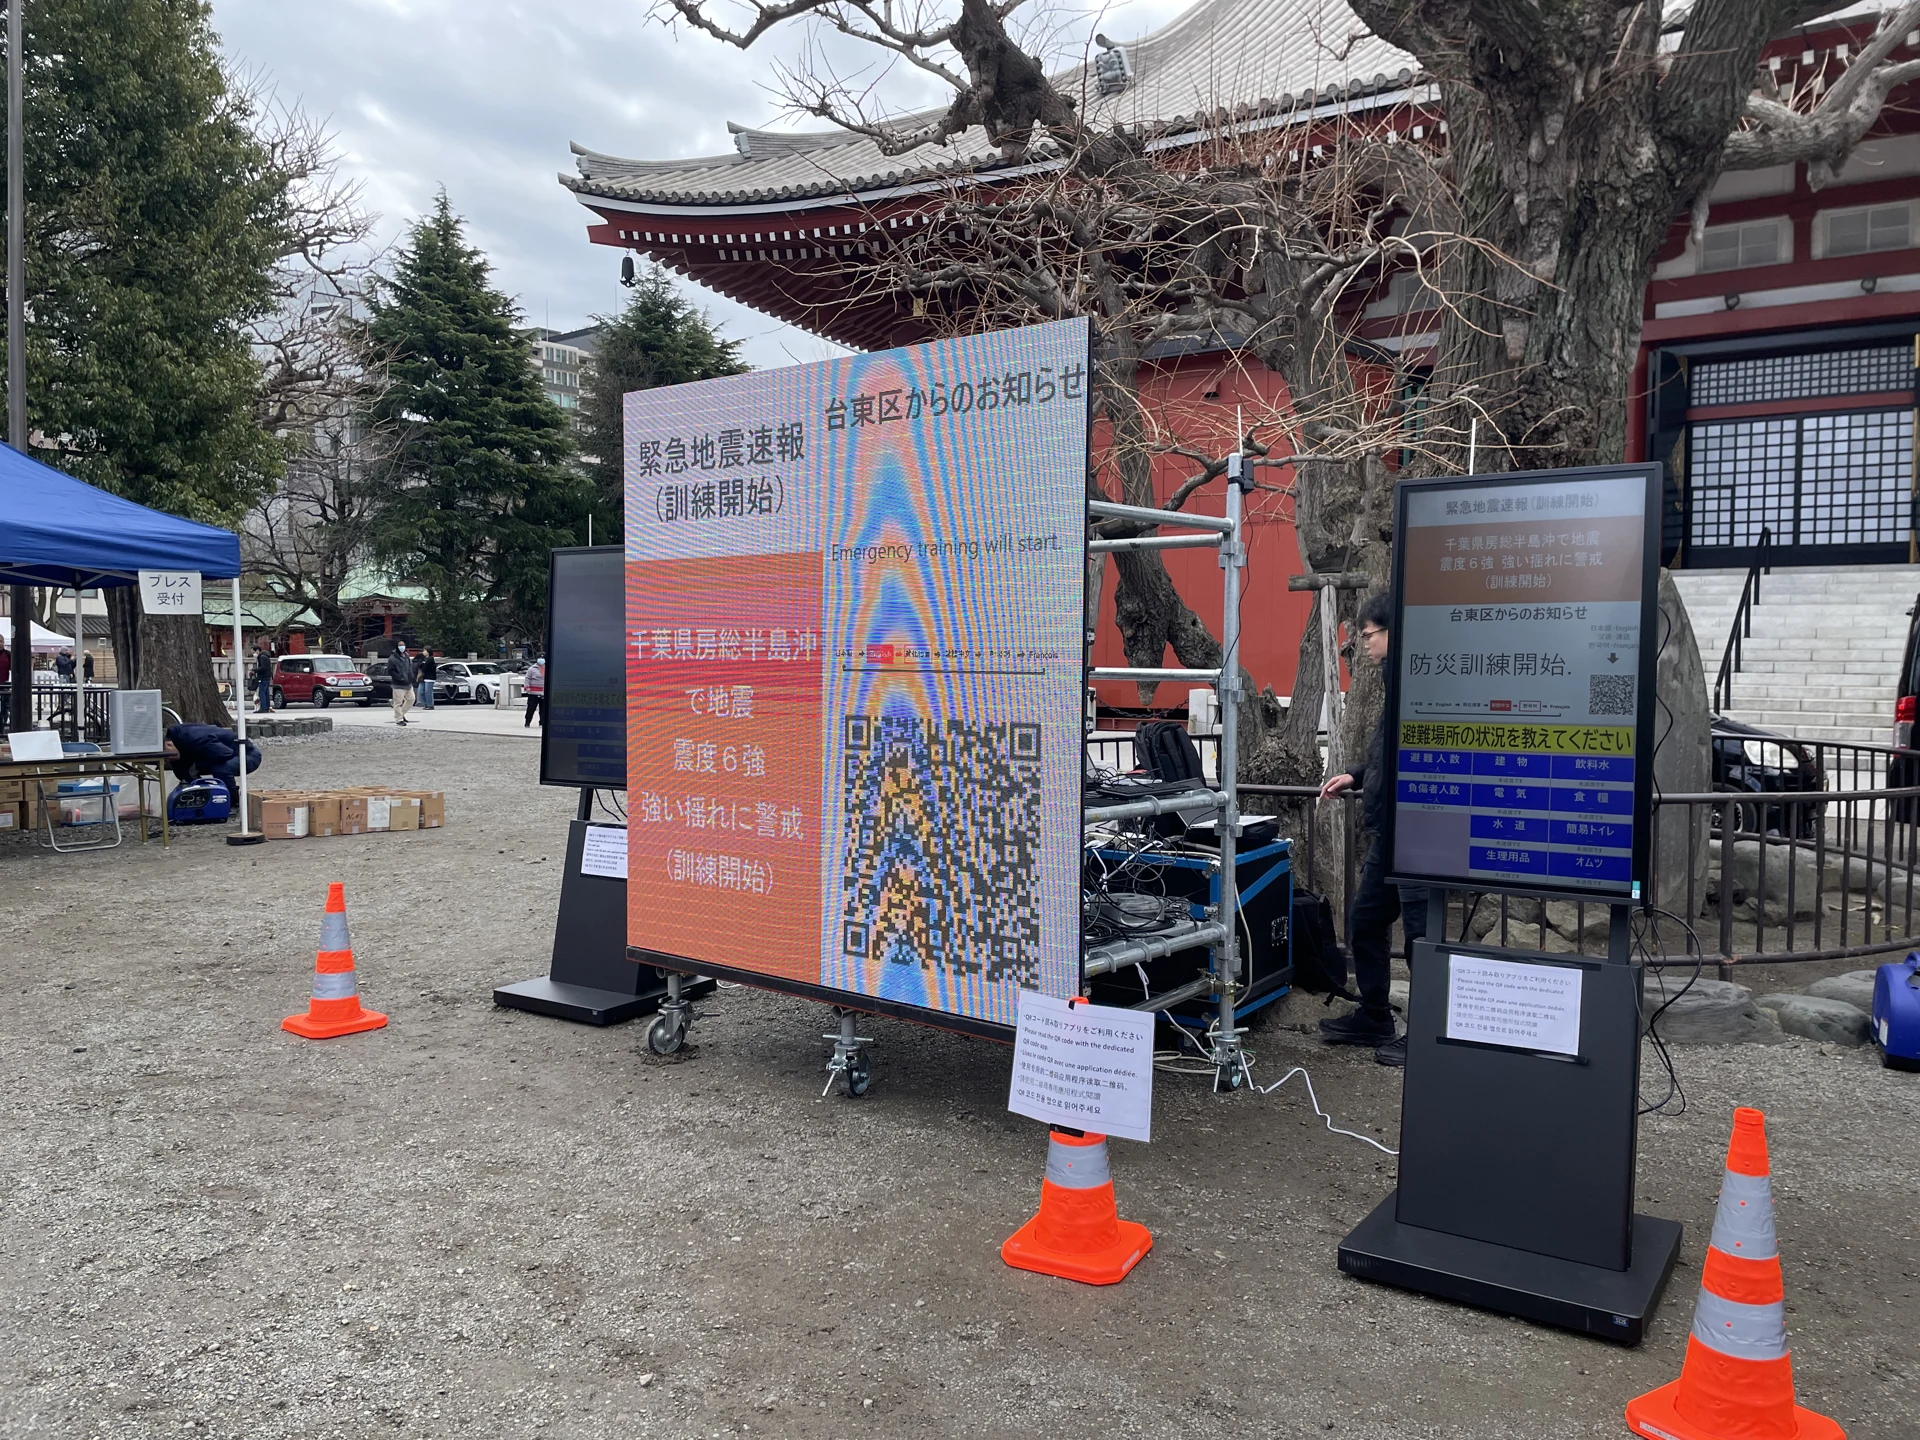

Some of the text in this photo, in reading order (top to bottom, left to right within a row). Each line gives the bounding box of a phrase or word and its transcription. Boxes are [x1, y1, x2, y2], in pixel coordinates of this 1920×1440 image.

[824, 363, 1085, 432] 台東区からのお知らせ
[639, 422, 805, 477] 緊急地震速報
[655, 475, 784, 522] (訓練開始)
[1446, 493, 1600, 516] 緊急地震速報(訓練開始)
[831, 534, 1061, 564] Emergency training will start.
[1445, 531, 1600, 551] 千葉県房総半島沖で地震
[1440, 552, 1603, 571] 震度6強 強い揺れに警戒
[148, 574, 191, 588] プレス
[1485, 574, 1552, 590] (訓練開始)
[157, 592, 184, 606] 受付
[1450, 606, 1587, 622] 台東区からのお知らせ
[631, 628, 816, 663] 千葉県房総半島沖
[1409, 653, 1572, 676] 防災訓練開始.
[686, 685, 754, 720] で地震
[1402, 724, 1631, 751] 避難場所の状況を教えてください
[673, 738, 765, 777] 震度6強
[1410, 753, 1459, 765] 避難人数
[1575, 758, 1609, 770] 飲料水
[1408, 783, 1459, 796] 負傷者人数
[641, 790, 804, 840] 強い揺れに警戒
[1493, 819, 1525, 831] 水道
[1567, 823, 1615, 836] 簡易トイレ
[1486, 851, 1530, 863] 生理用品
[1575, 857, 1603, 868] オムツ
[667, 849, 774, 895] (訓練開始)
[1539, 987, 1563, 995] dedicated
[1024, 1027, 1037, 1036] Please
[1103, 1044, 1134, 1053] dedicated
[1047, 1056, 1053, 1064] QR
[1077, 1063, 1113, 1074] application
